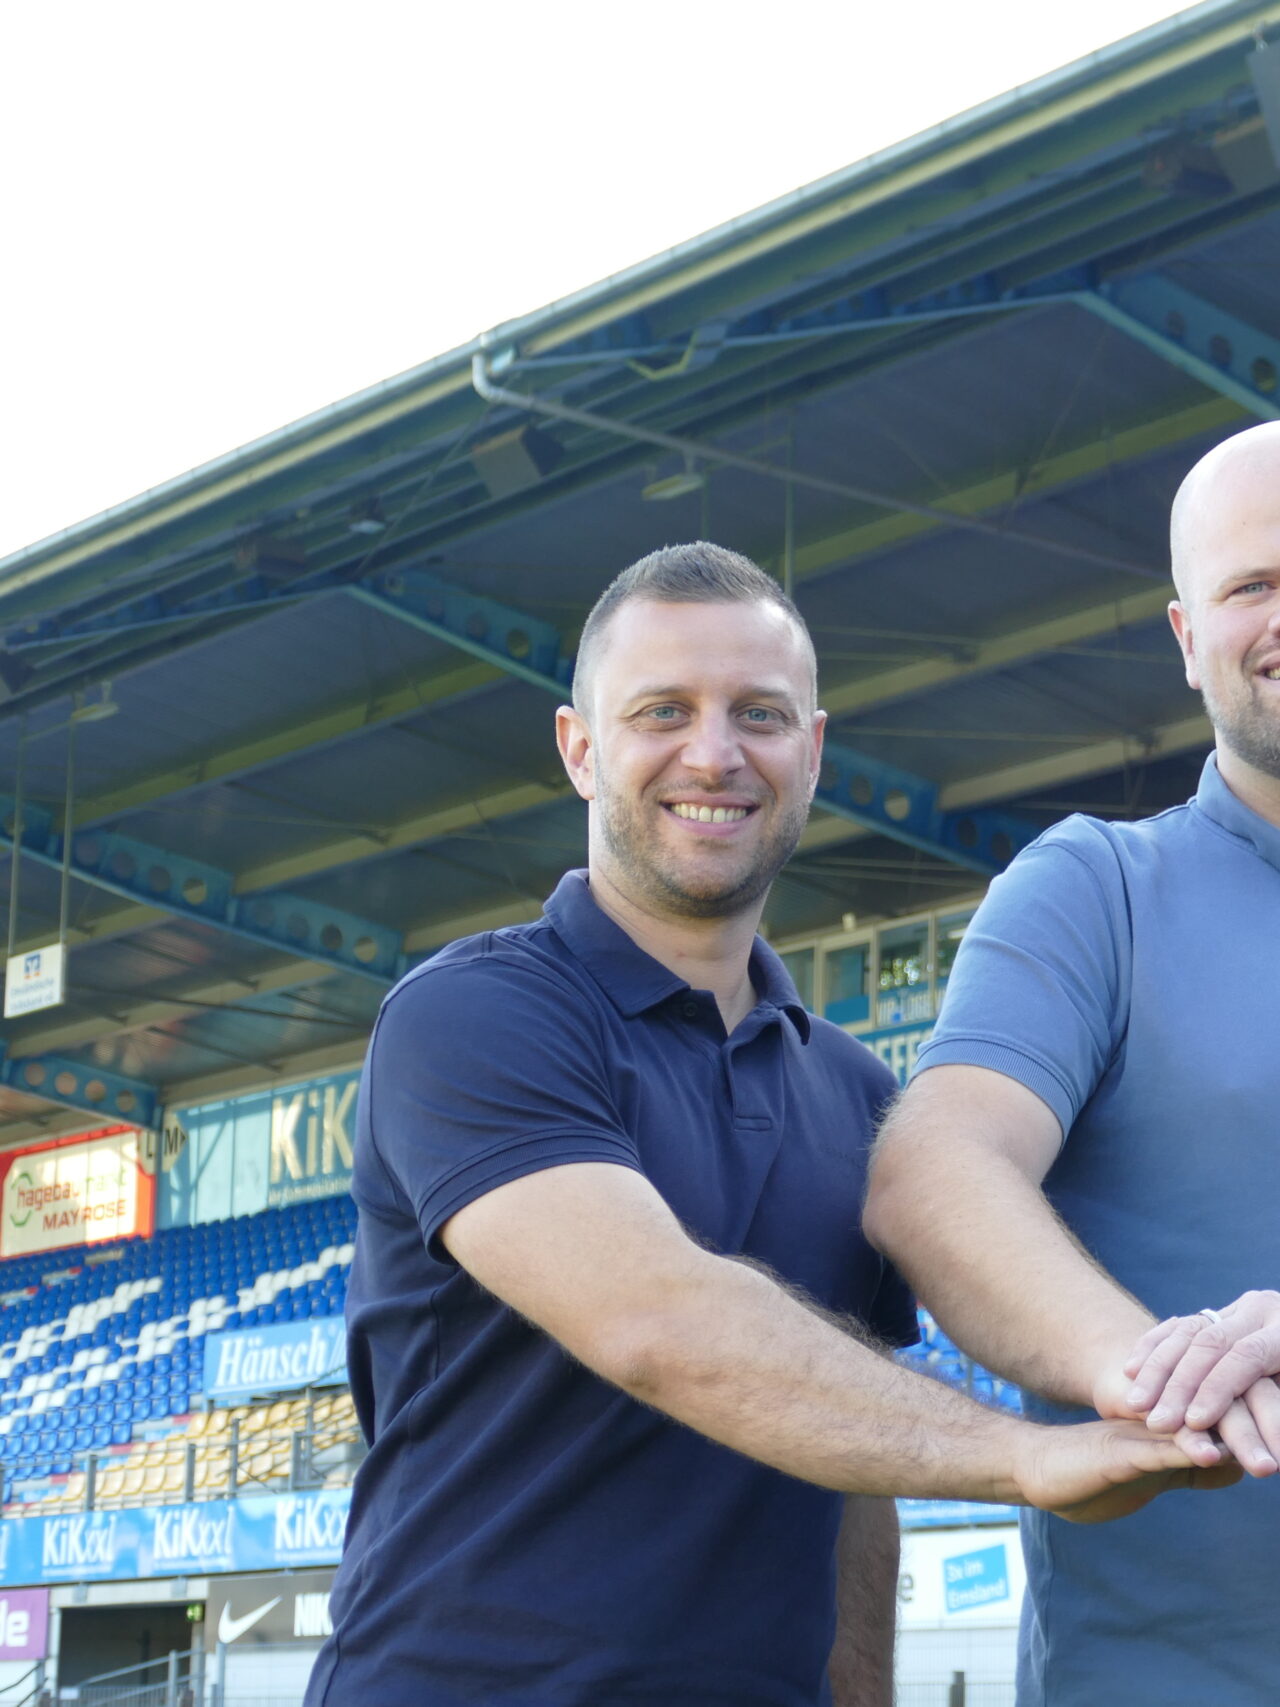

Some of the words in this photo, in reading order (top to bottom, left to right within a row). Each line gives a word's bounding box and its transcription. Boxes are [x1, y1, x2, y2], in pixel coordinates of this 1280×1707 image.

[270, 1080, 358, 1185] KiK
[43, 1199, 126, 1231] MAYROSE
[214, 1325, 328, 1387] Hänsch
[42, 1513, 117, 1567] KiKxxl
[153, 1505, 235, 1560] KiKxxl
[274, 1496, 350, 1551] KiKxx
[294, 1592, 336, 1637] NIK
